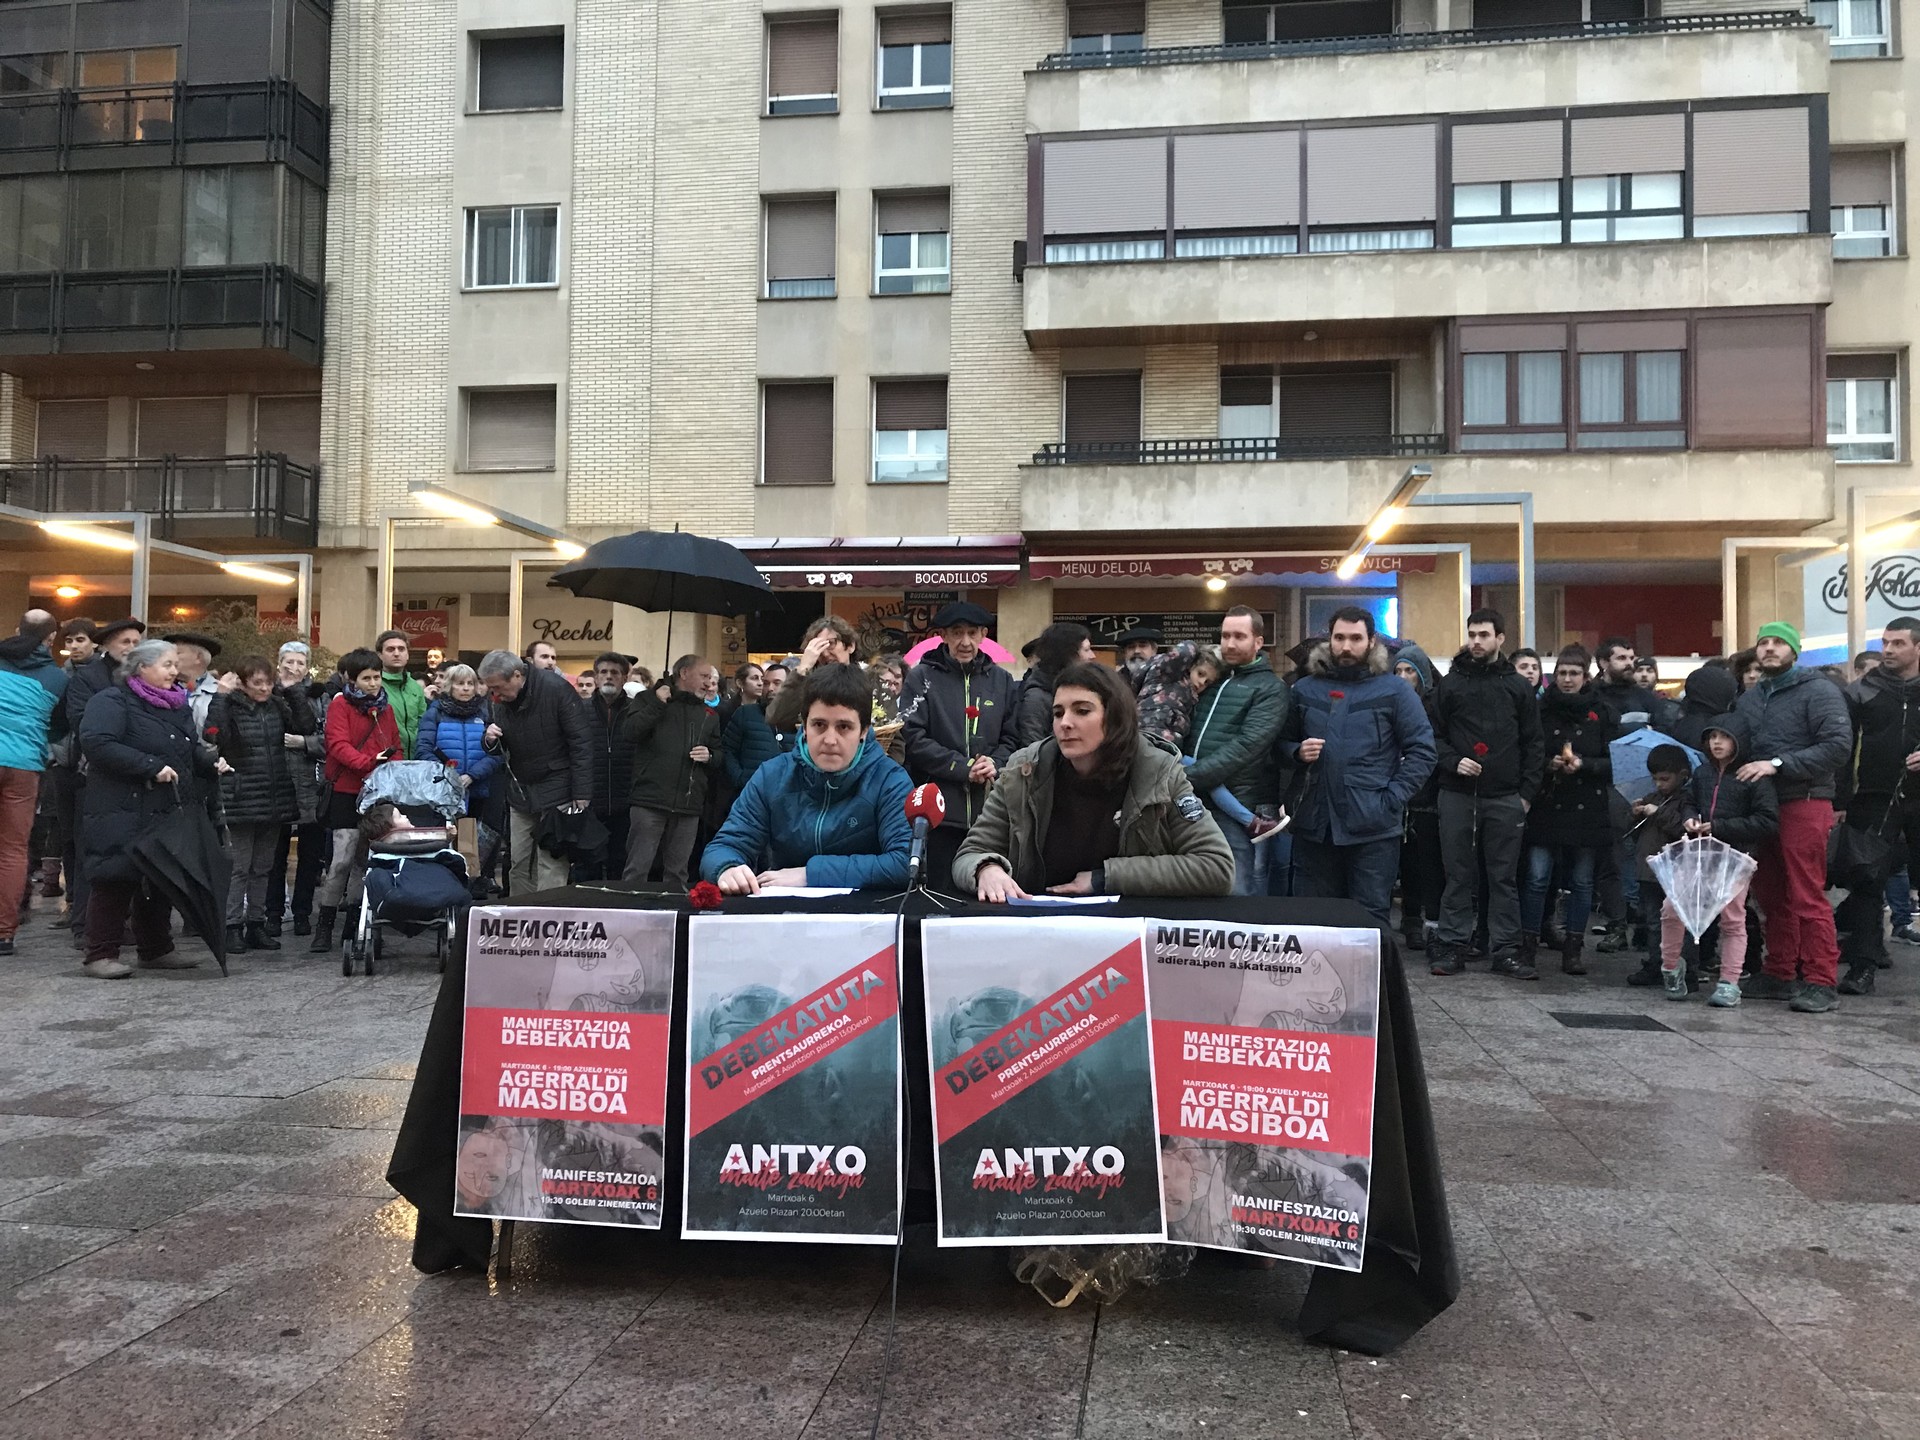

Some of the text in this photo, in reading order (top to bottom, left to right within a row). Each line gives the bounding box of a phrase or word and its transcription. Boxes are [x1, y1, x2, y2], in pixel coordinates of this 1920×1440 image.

[1062, 562, 1152, 574] MENU DEL DIA
[1320, 557, 1402, 570] SAWICH
[915, 572, 988, 584] BOCADILLOS
[533, 618, 613, 640] Rechel
[477, 922, 612, 953] ez da delitua
[480, 919, 608, 940] MEMORIA
[1157, 926, 1302, 955] MEMORIA
[480, 947, 607, 959] adierazpen askatasuna
[1154, 931, 1309, 966] ez da delitua
[1158, 956, 1302, 974] adierazpen askatasuna
[502, 1016, 631, 1033] MANIFESTAZIOA
[701, 969, 885, 1089] DEBEKATUTA
[945, 967, 1129, 1095] DEBEKATUTA
[502, 1029, 630, 1050] DEBEKATUA
[751, 1014, 851, 1079] PRENTSAURREKOA
[998, 1014, 1098, 1083] PRENTSAURREKOA
[1184, 1030, 1331, 1055] MANIFESTAZIOA
[501, 1062, 540, 1070] MARTXOAK
[744, 1074, 775, 1096] Martxoak
[782, 1049, 816, 1072] Asuntzion
[816, 1034, 839, 1052] plazan
[991, 1078, 1023, 1100] Martxoak
[1029, 1051, 1063, 1075] Asuntzion
[1064, 1036, 1087, 1054] plazan
[1183, 1044, 1331, 1073] DEBEKATUA
[499, 1070, 627, 1092] AGERRALDI
[1183, 1080, 1228, 1089] MARTXOAK
[1243, 1085, 1264, 1093] 19:00
[1266, 1087, 1299, 1096] AZUELO
[1302, 1091, 1328, 1099] PLAZA
[498, 1087, 627, 1114] MASIBOA
[1181, 1088, 1329, 1118] AGERRALDI
[1180, 1105, 1329, 1142] MASIBOA
[720, 1144, 866, 1176] ANTXO
[973, 1145, 1124, 1179] ANTXO
[542, 1168, 657, 1185] MANIFESTAZIOA
[719, 1158, 866, 1200] maite zaitugu
[972, 1161, 1125, 1200] maite zaitugu
[542, 1180, 657, 1200] MARTXOAK 6
[768, 1194, 814, 1203] Martxoak 6
[1024, 1196, 1073, 1205] Martxoak 6
[565, 1198, 595, 1206] GOLEM
[598, 1200, 656, 1210] ZINEMETATIK
[739, 1207, 768, 1216] Azuelo
[771, 1208, 798, 1217] Plazan
[996, 1211, 1026, 1220] Azuelo
[1029, 1211, 1058, 1220] Plazan
[1231, 1195, 1360, 1224] MANIFESTAZIOA
[1231, 1206, 1358, 1240] MARTXOAK 6
[1231, 1224, 1358, 1251] 19:30 GOLEM ZINEMETATIK
